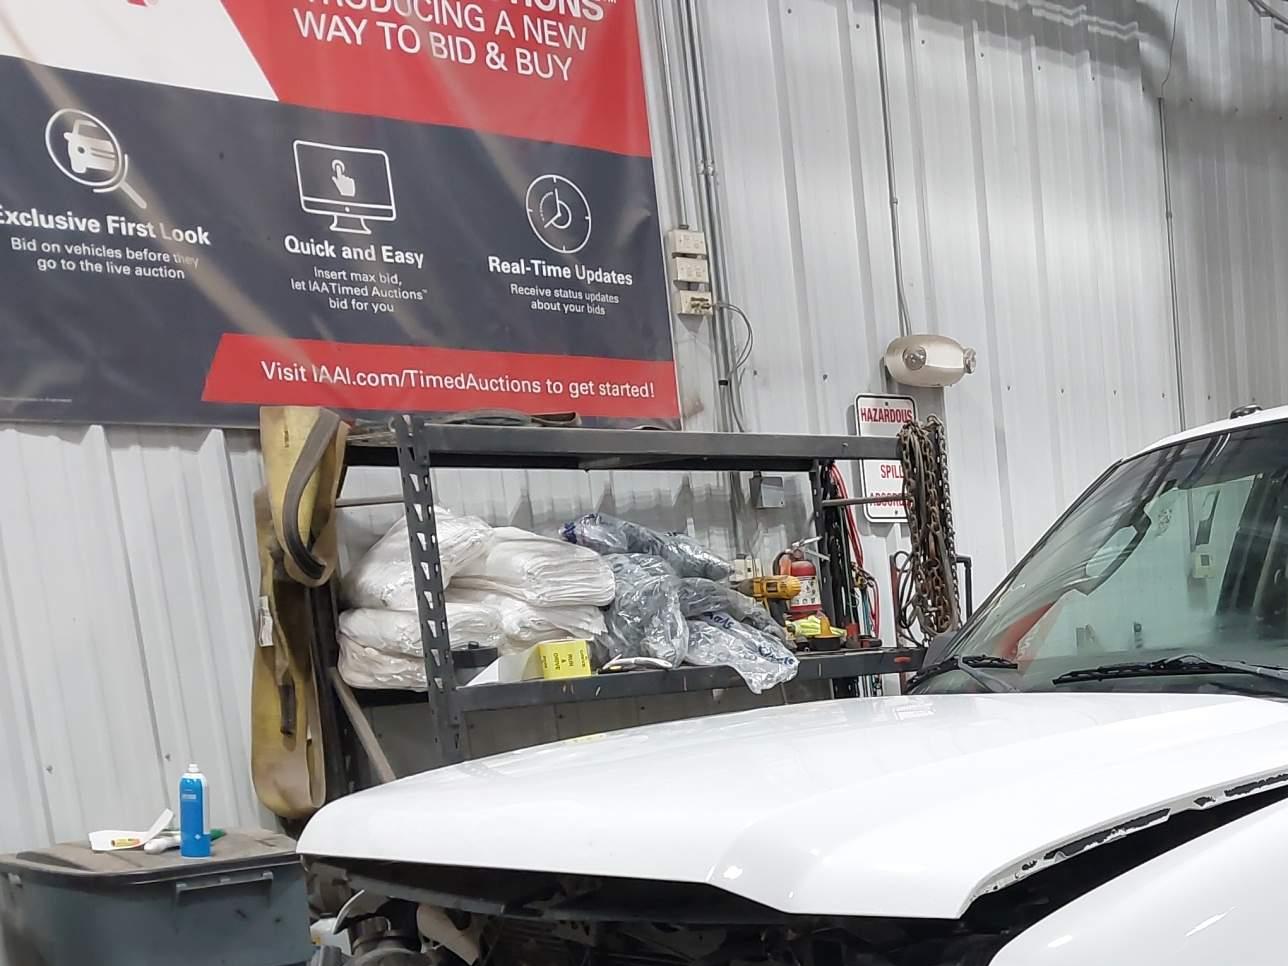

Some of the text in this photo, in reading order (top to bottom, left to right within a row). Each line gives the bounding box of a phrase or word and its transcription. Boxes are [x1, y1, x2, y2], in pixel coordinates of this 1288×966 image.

[495, 10, 516, 38] A
[523, 15, 586, 50] NEW
[293, 8, 573, 81] WAY TO BID & BUY
[106, 215, 156, 238] First
[159, 223, 211, 245] Look
[11, 237, 199, 270] Bid on vehicles before they
[284, 235, 424, 269] Quick and Easy
[37, 258, 185, 279] go to the live auction
[314, 266, 402, 286] Insert max bid,
[488, 256, 633, 285] Real-Time Updates
[291, 278, 306, 291] let
[510, 284, 619, 304] Receive status updates
[329, 298, 395, 313] bid for you
[531, 300, 606, 315] about your bids
[261, 361, 655, 398] Visit IAAI.com/TimedAuctions to get started!
[861, 407, 913, 423] HAZARDOUS
